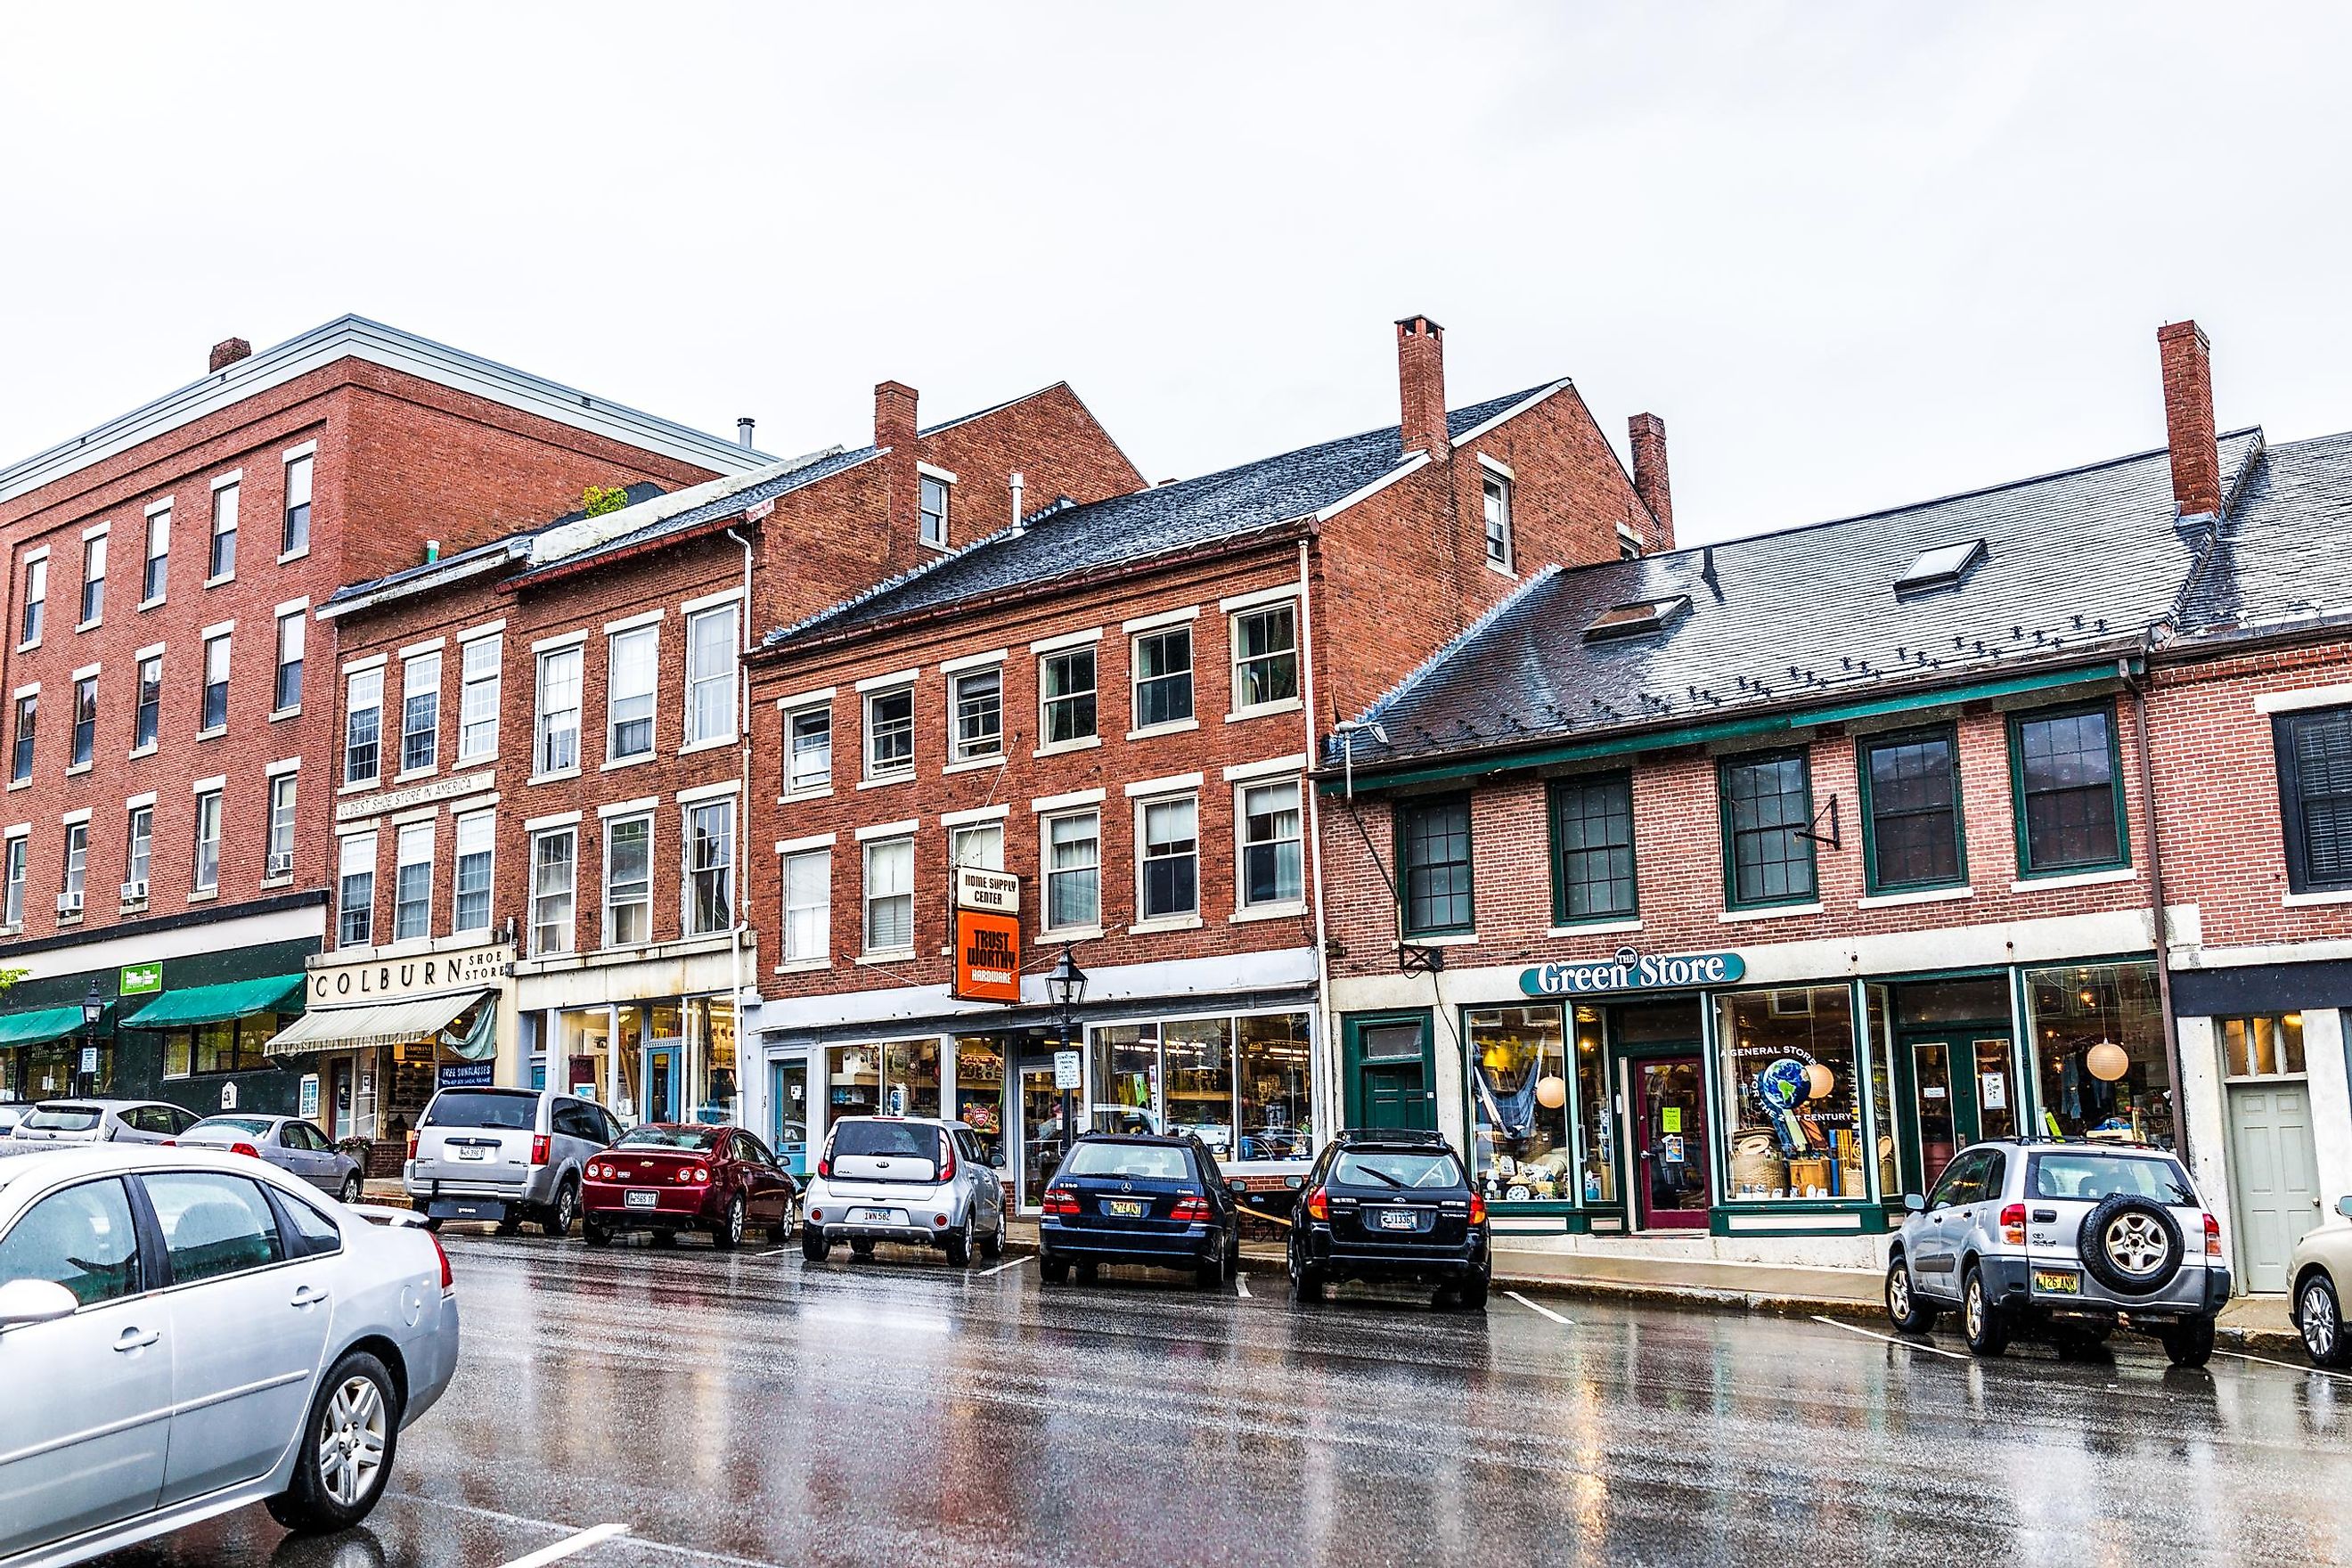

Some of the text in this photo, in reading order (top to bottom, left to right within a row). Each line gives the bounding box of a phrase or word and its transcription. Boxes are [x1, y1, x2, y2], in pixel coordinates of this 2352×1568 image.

[340, 801, 369, 817] OLDEST
[372, 796, 392, 810] SHOE
[395, 788, 421, 805] STORE
[424, 787, 431, 798] IN
[435, 777, 471, 797] AMERICA
[965, 874, 1017, 893] HOME SUPPLY
[974, 891, 1002, 905] CENTER
[974, 928, 1010, 952] TRUST
[470, 951, 502, 965] SHOE
[967, 947, 1016, 970] WORTHY
[1618, 954, 1635, 964] THE
[315, 959, 461, 998] COLBURN
[465, 966, 504, 981] STORE
[971, 968, 1012, 984] HARDWARE
[1538, 954, 1726, 994] Green Store
[1730, 1046, 1781, 1058] GENERAL
[1783, 1045, 1817, 1066] STORE
[1752, 1073, 1760, 1098] FOR
[1758, 1099, 1776, 1118] THE
[1803, 1113, 1852, 1122] CENTURY
